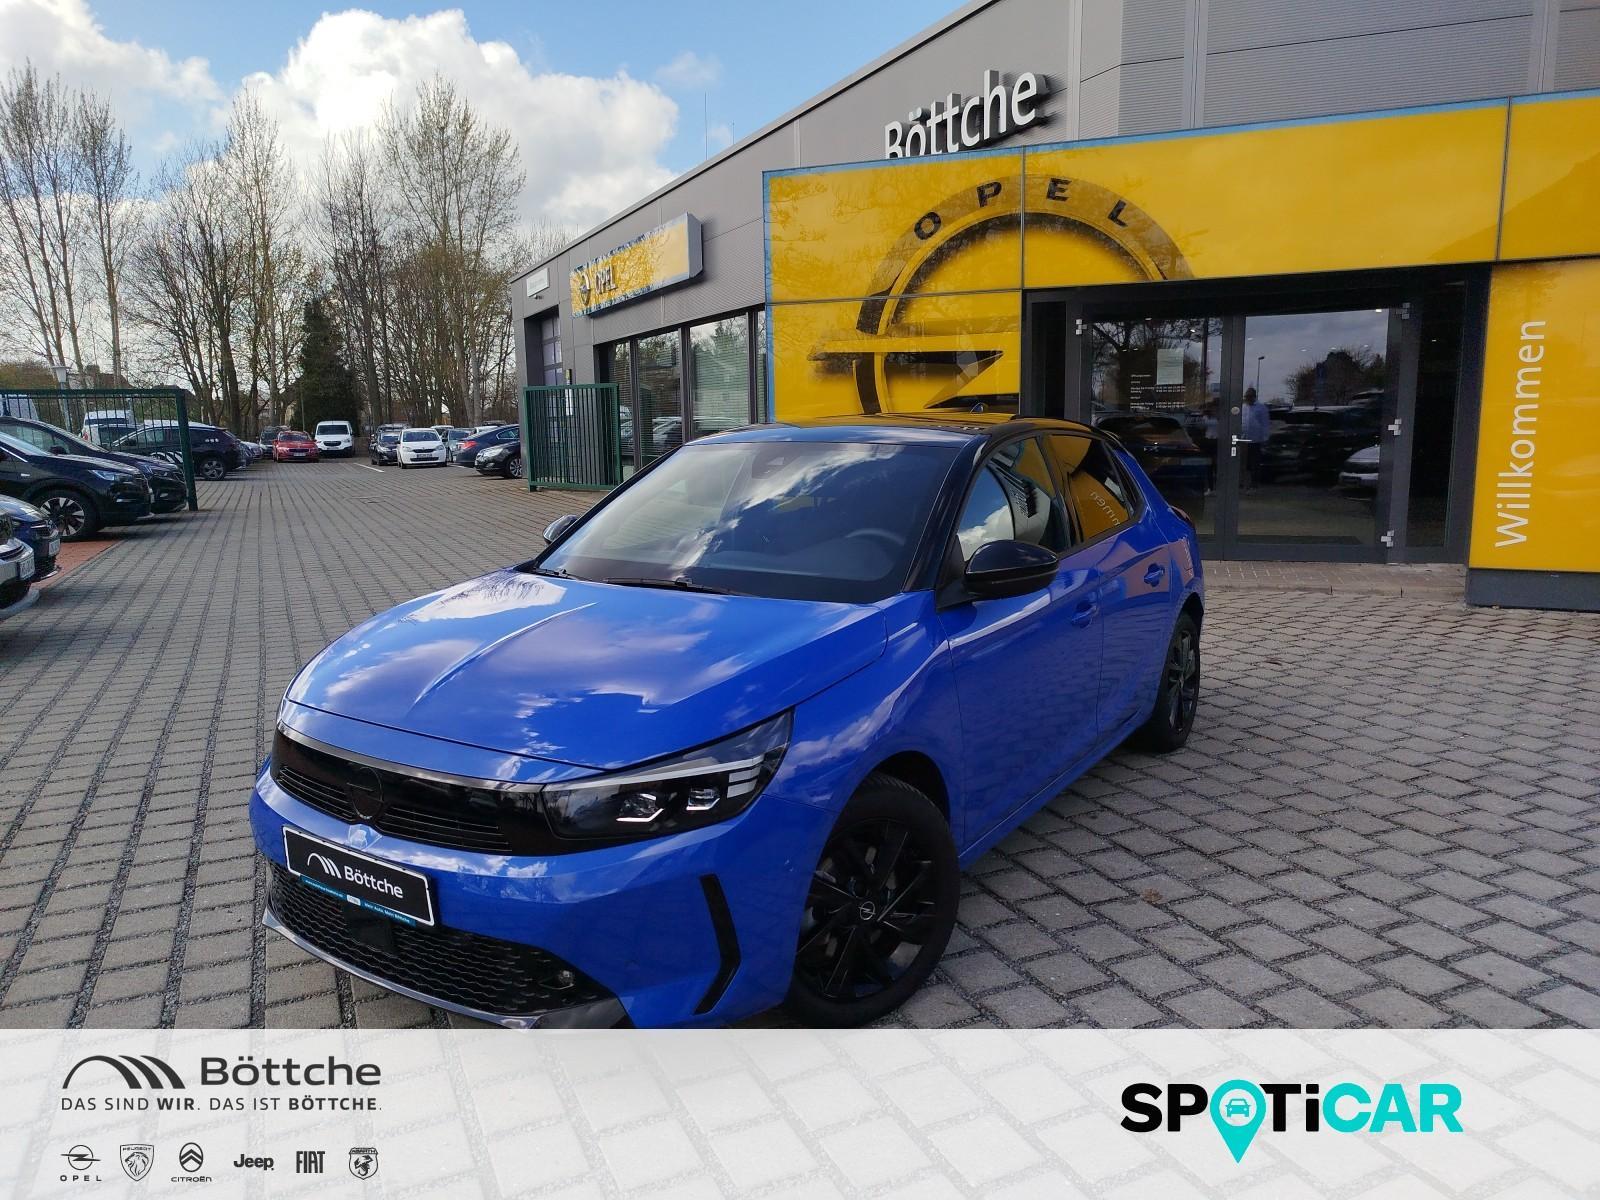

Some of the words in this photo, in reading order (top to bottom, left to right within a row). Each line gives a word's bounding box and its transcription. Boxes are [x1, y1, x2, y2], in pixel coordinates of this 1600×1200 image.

[885, 69, 1038, 160] Böttche
[913, 177, 1130, 241] OPEL
[1494, 320, 1547, 548] Willkommen
[343, 865, 404, 899] Böttche
